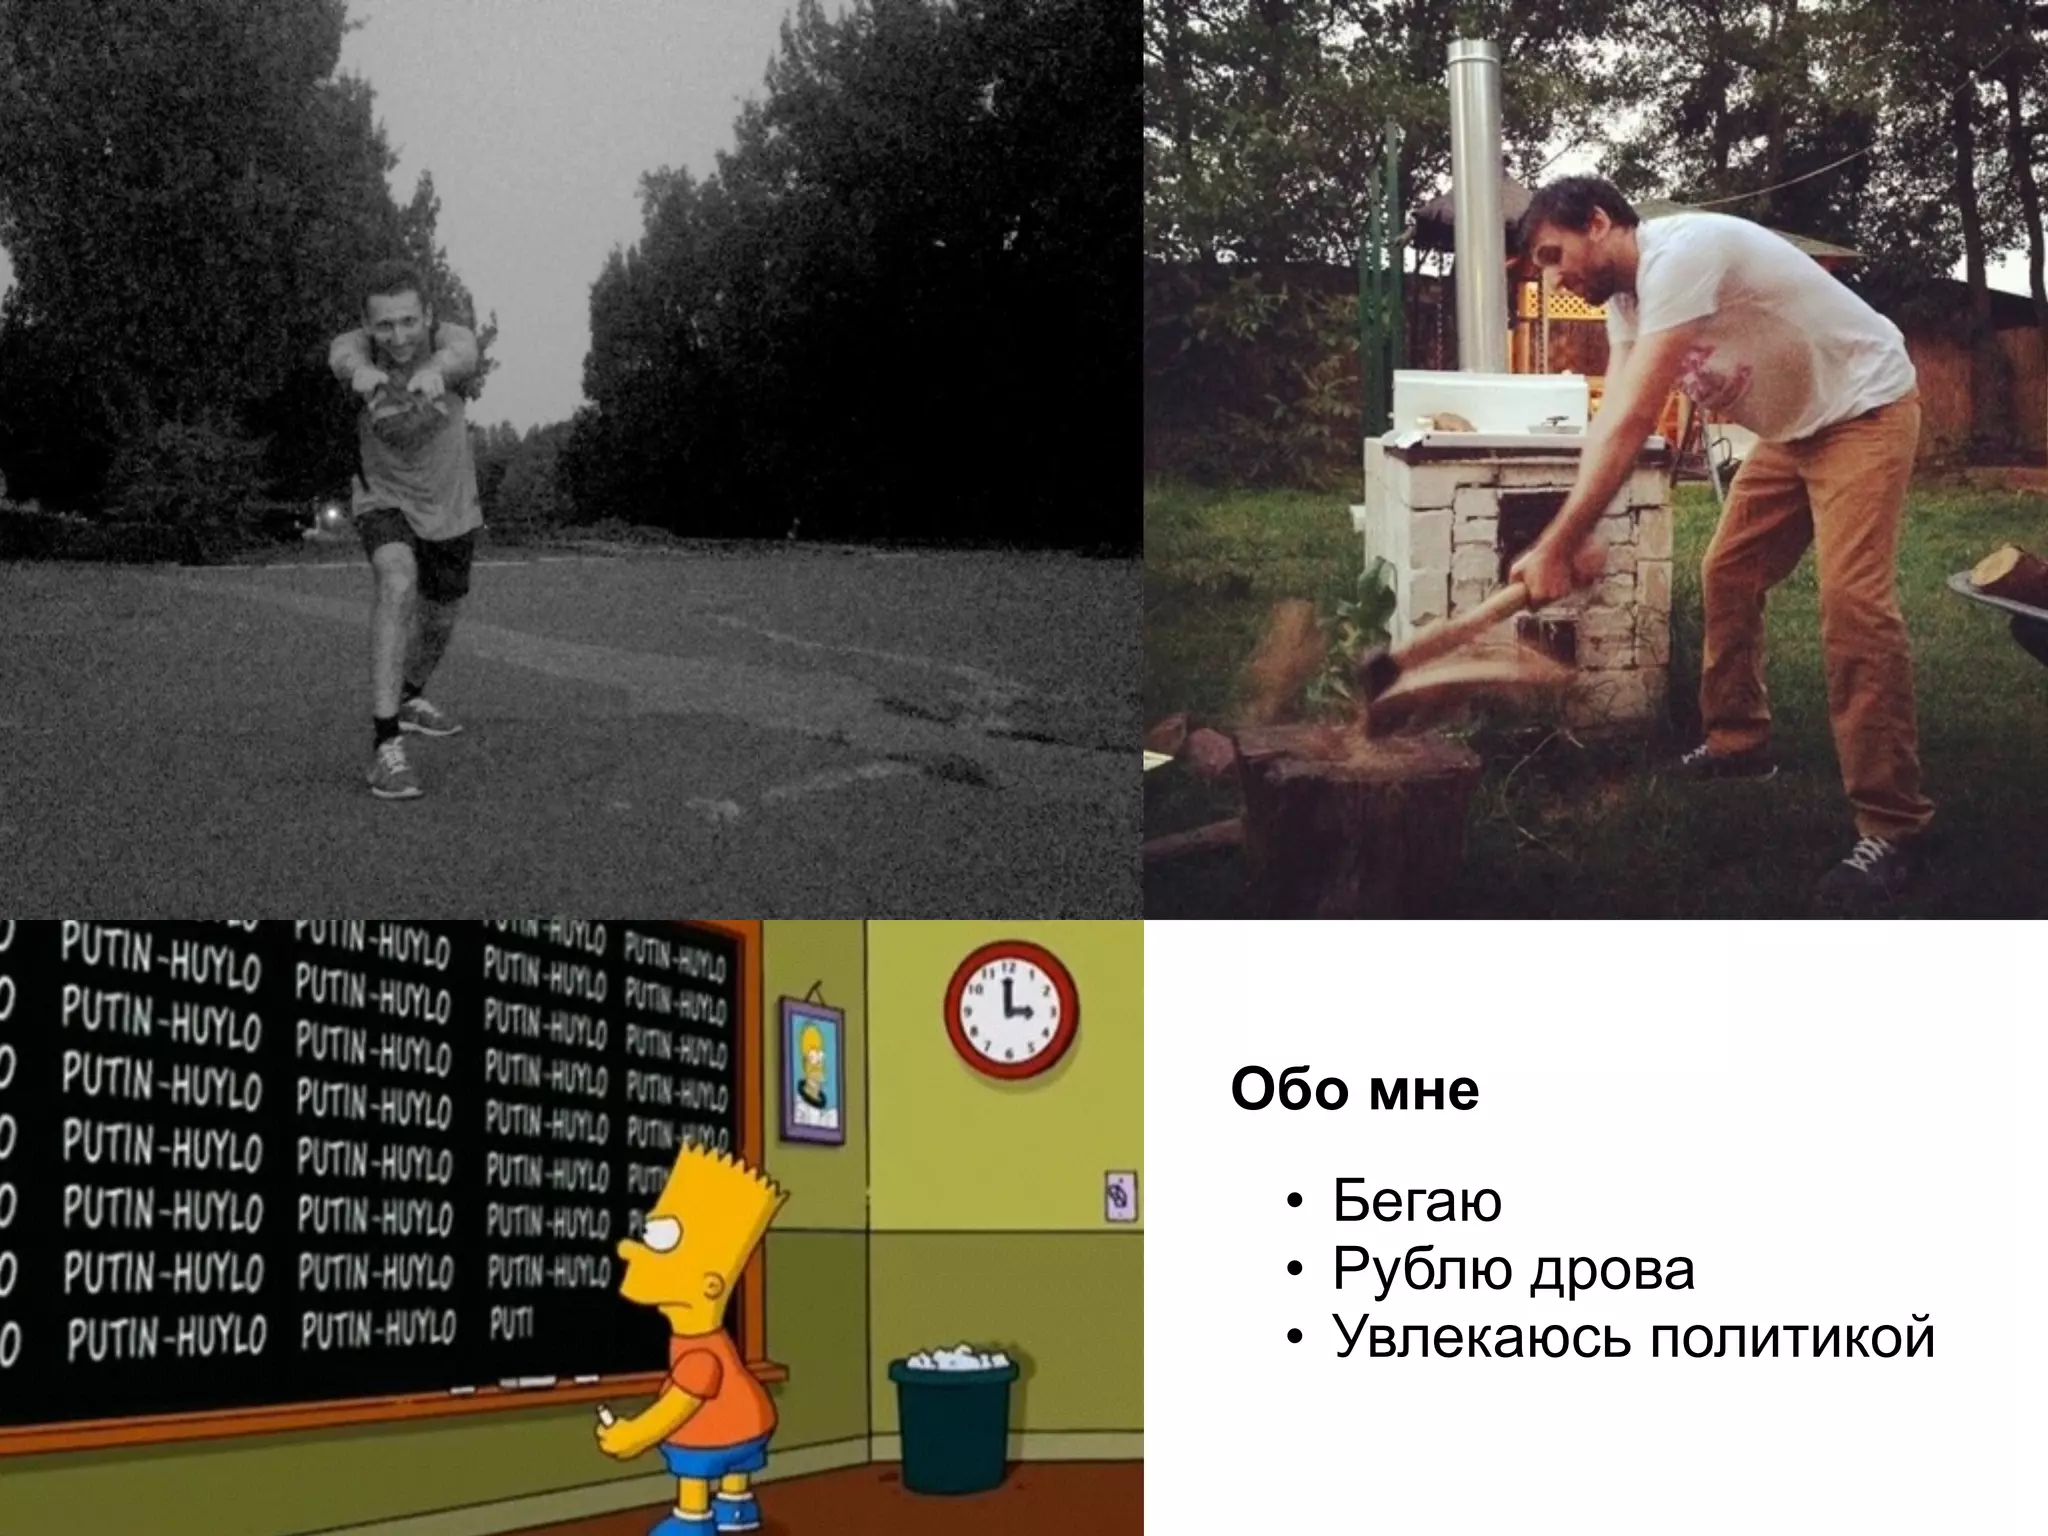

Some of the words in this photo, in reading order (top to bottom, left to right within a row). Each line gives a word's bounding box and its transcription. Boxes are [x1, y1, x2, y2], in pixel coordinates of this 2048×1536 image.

[61, 920, 262, 994] PUTIN-HUYLO
[484, 944, 607, 1003] PUTIN-HUYLO
[625, 930, 727, 985] PUTIN-HUYLO
[62, 983, 262, 1053] PUTIN-HUYLO
[295, 961, 452, 1025] PUTIN-HUYLO
[625, 976, 727, 1028] PUTIN-HUYLO
[296, 1019, 452, 1078] PUTIN-HUYLO
[485, 996, 608, 1051] PUTIN-HUYLO
[626, 1023, 728, 1071] PUTIN-HUYLO
[62, 1049, 263, 1113] PUTIN-HUYLO
[485, 1047, 609, 1098] PUTIN-HUYLO
[627, 1069, 729, 1114] PUTIN-HUYLO
[297, 1076, 453, 1131] PUTIN-HUYLO
[486, 1098, 609, 1146] PUTIN-HUYLO
[63, 1116, 263, 1174] PUTIN-HUYLO
[297, 1135, 453, 1185] PUTIN-HUYLO
[487, 1150, 610, 1194] PUTIN-HUYLO
[63, 1183, 264, 1234] PUTIN-HUYLO
[298, 1193, 454, 1238] PUTIN-HUYLO
[487, 1202, 610, 1241] PUTIN-HUYLO
[64, 1249, 265, 1294] PUTIN-HUYLO
[299, 1251, 454, 1291] PUTIN-HUYLO
[488, 1254, 611, 1289] PUTIN-HUYLO
[67, 1313, 267, 1362] PUTIN-HUYLO
[301, 1308, 457, 1351] PUTIN-HUYLO
[490, 1305, 534, 1342] PUTI
